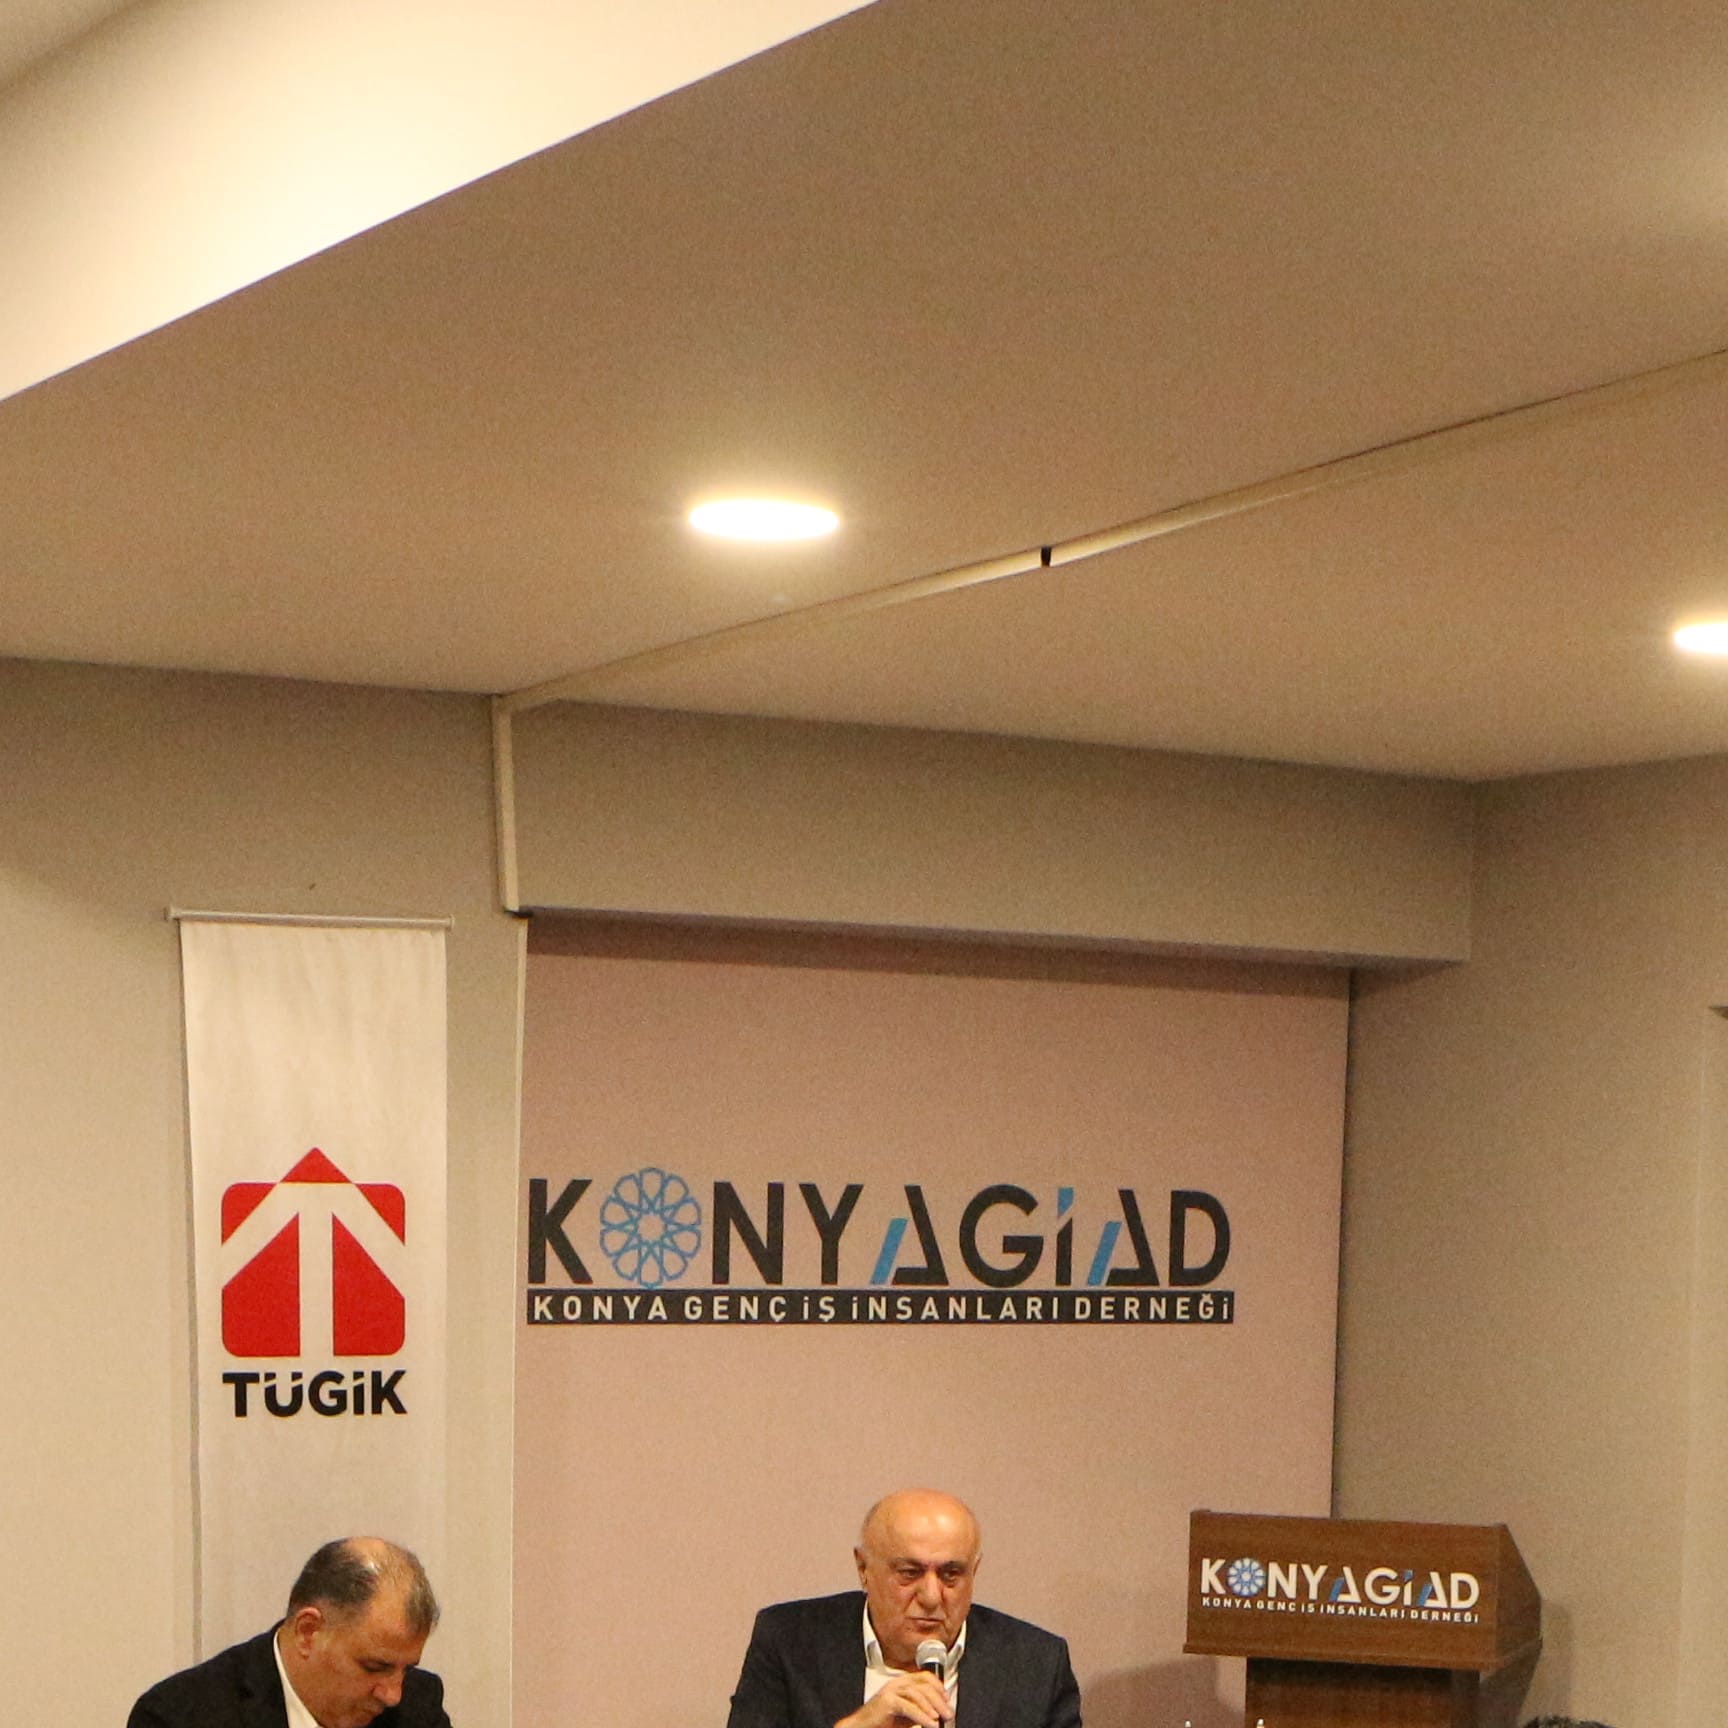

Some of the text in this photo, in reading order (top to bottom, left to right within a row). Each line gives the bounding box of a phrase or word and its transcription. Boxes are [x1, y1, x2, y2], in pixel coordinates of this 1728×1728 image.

[533, 1293, 1230, 1323] KONYA GENÇ İŞ İNSANLARI DERNEĞİ
[1201, 1596, 1252, 1609] KONYA
